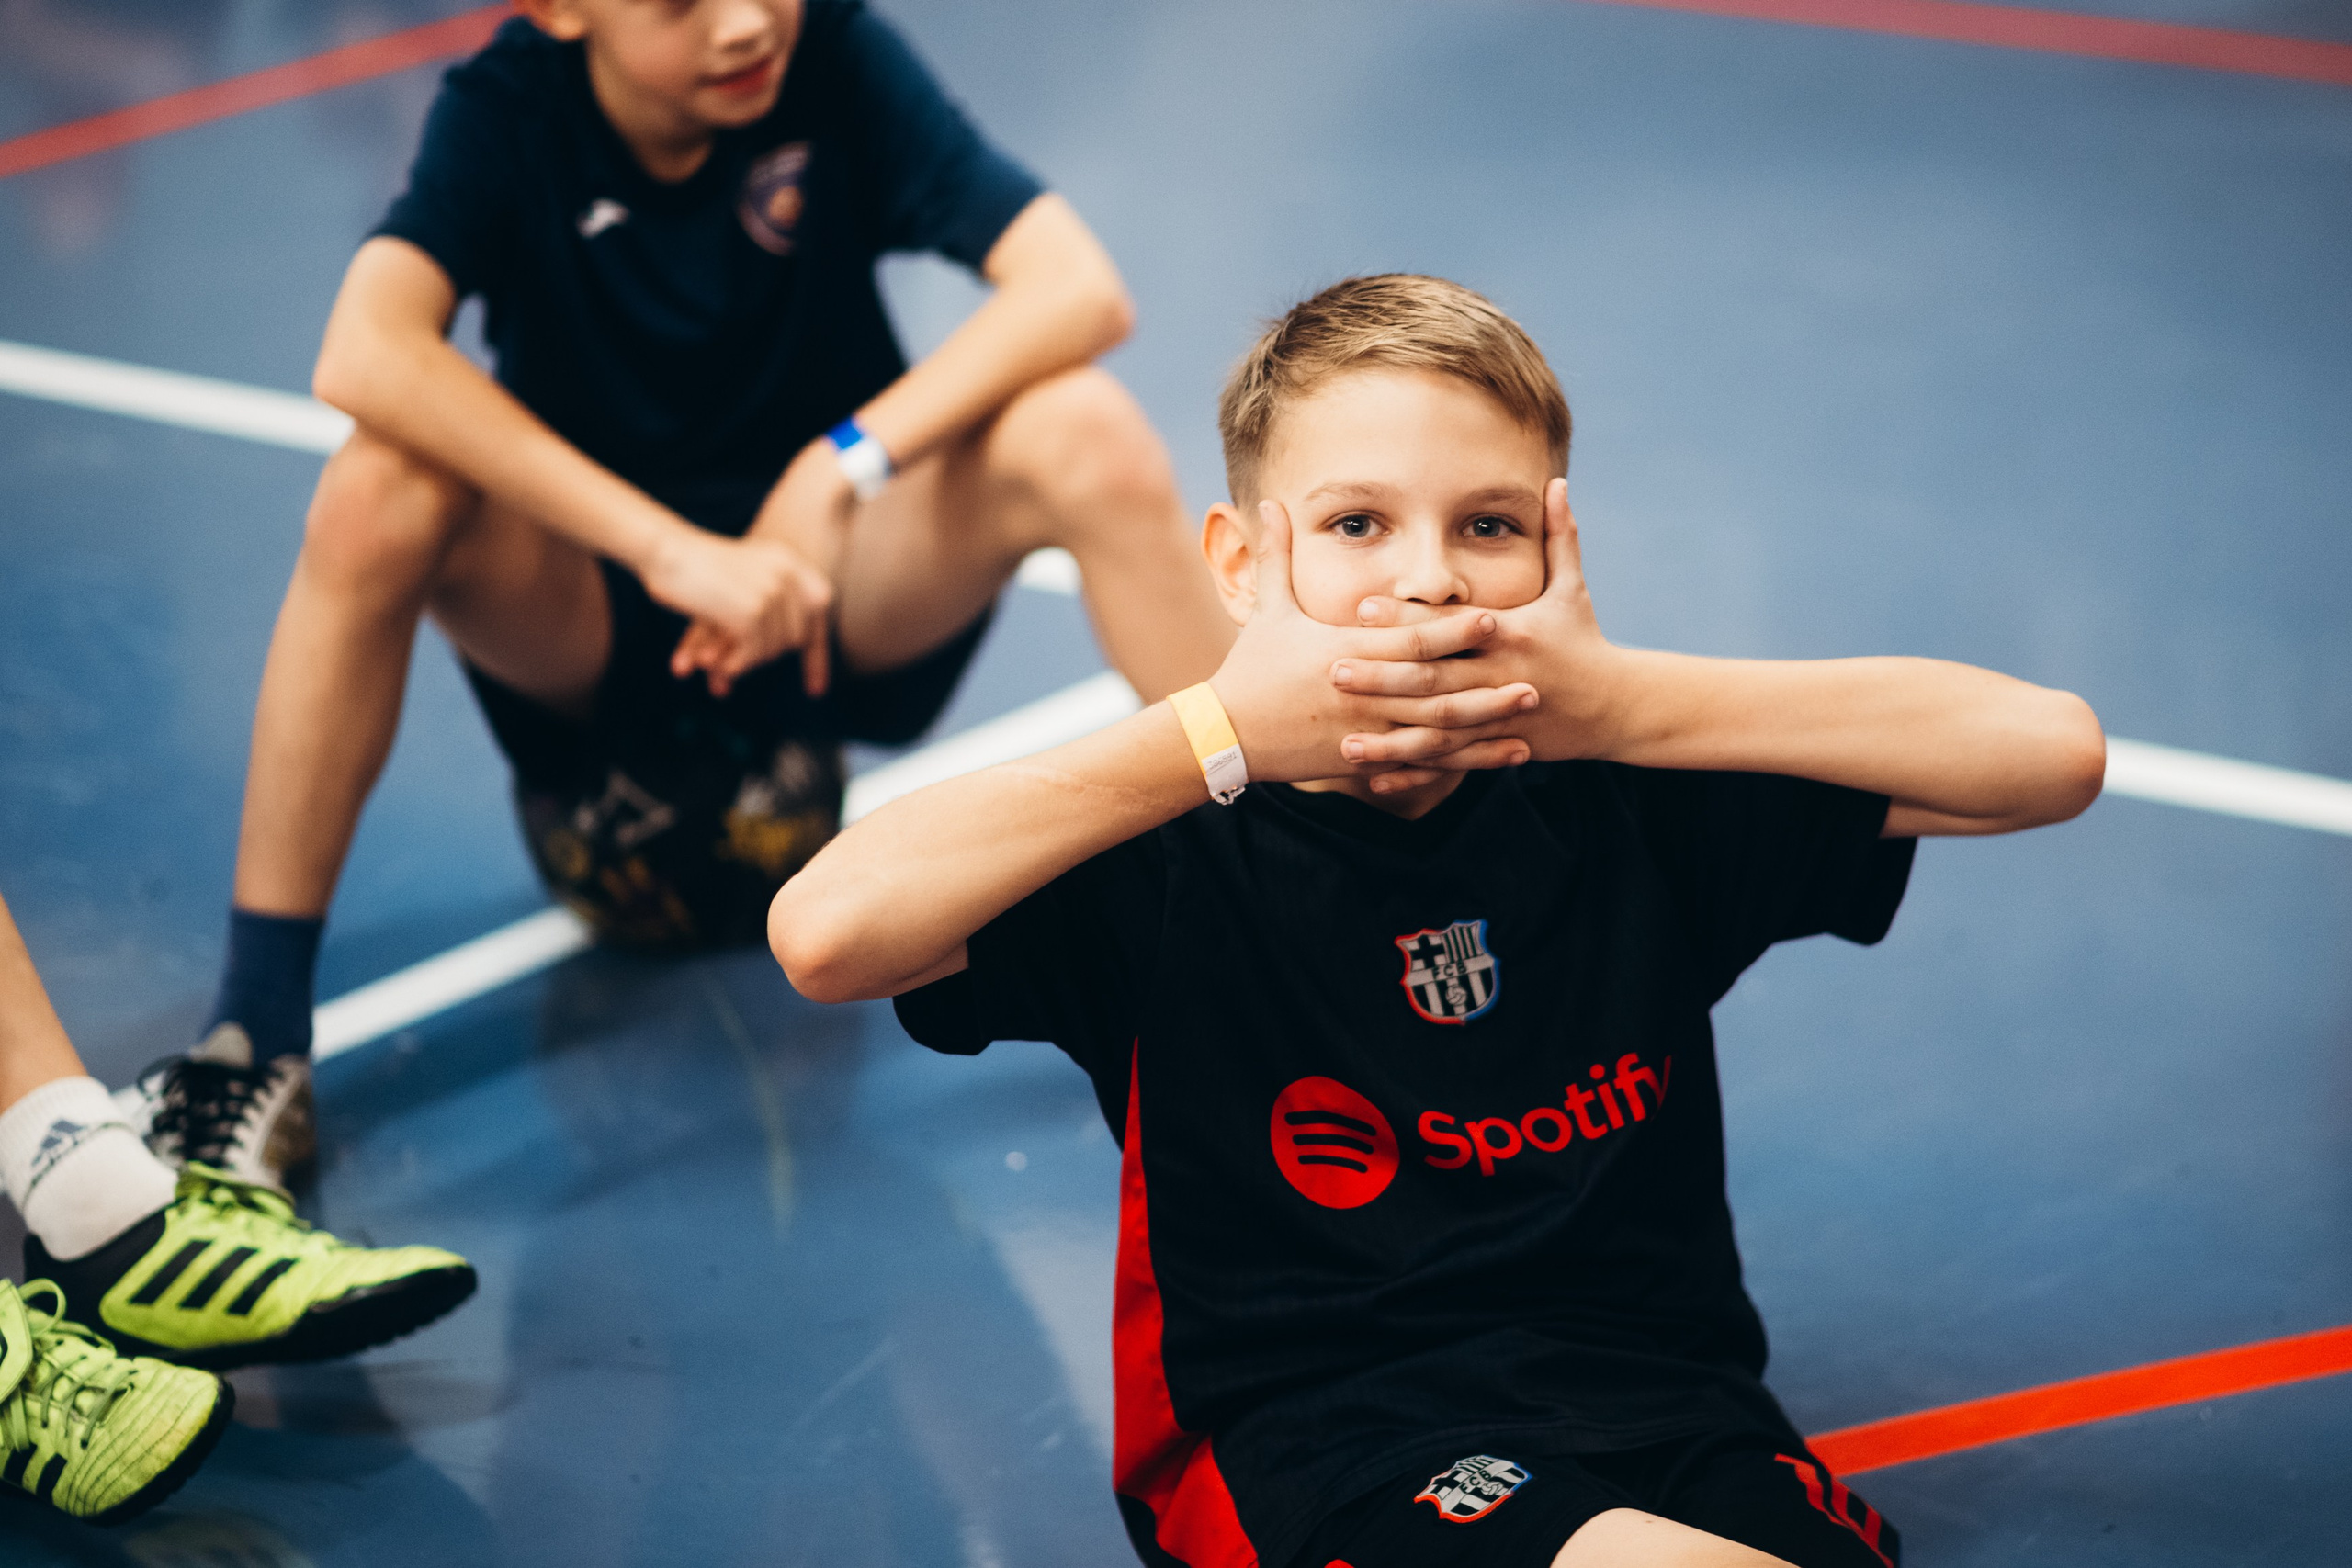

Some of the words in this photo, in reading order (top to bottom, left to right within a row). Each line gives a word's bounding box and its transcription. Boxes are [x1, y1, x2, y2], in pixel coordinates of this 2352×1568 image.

[1432, 961, 1467, 979] FCB
[1417, 1052, 1672, 1177] Spotify
[1459, 1470, 1493, 1494] FCB
